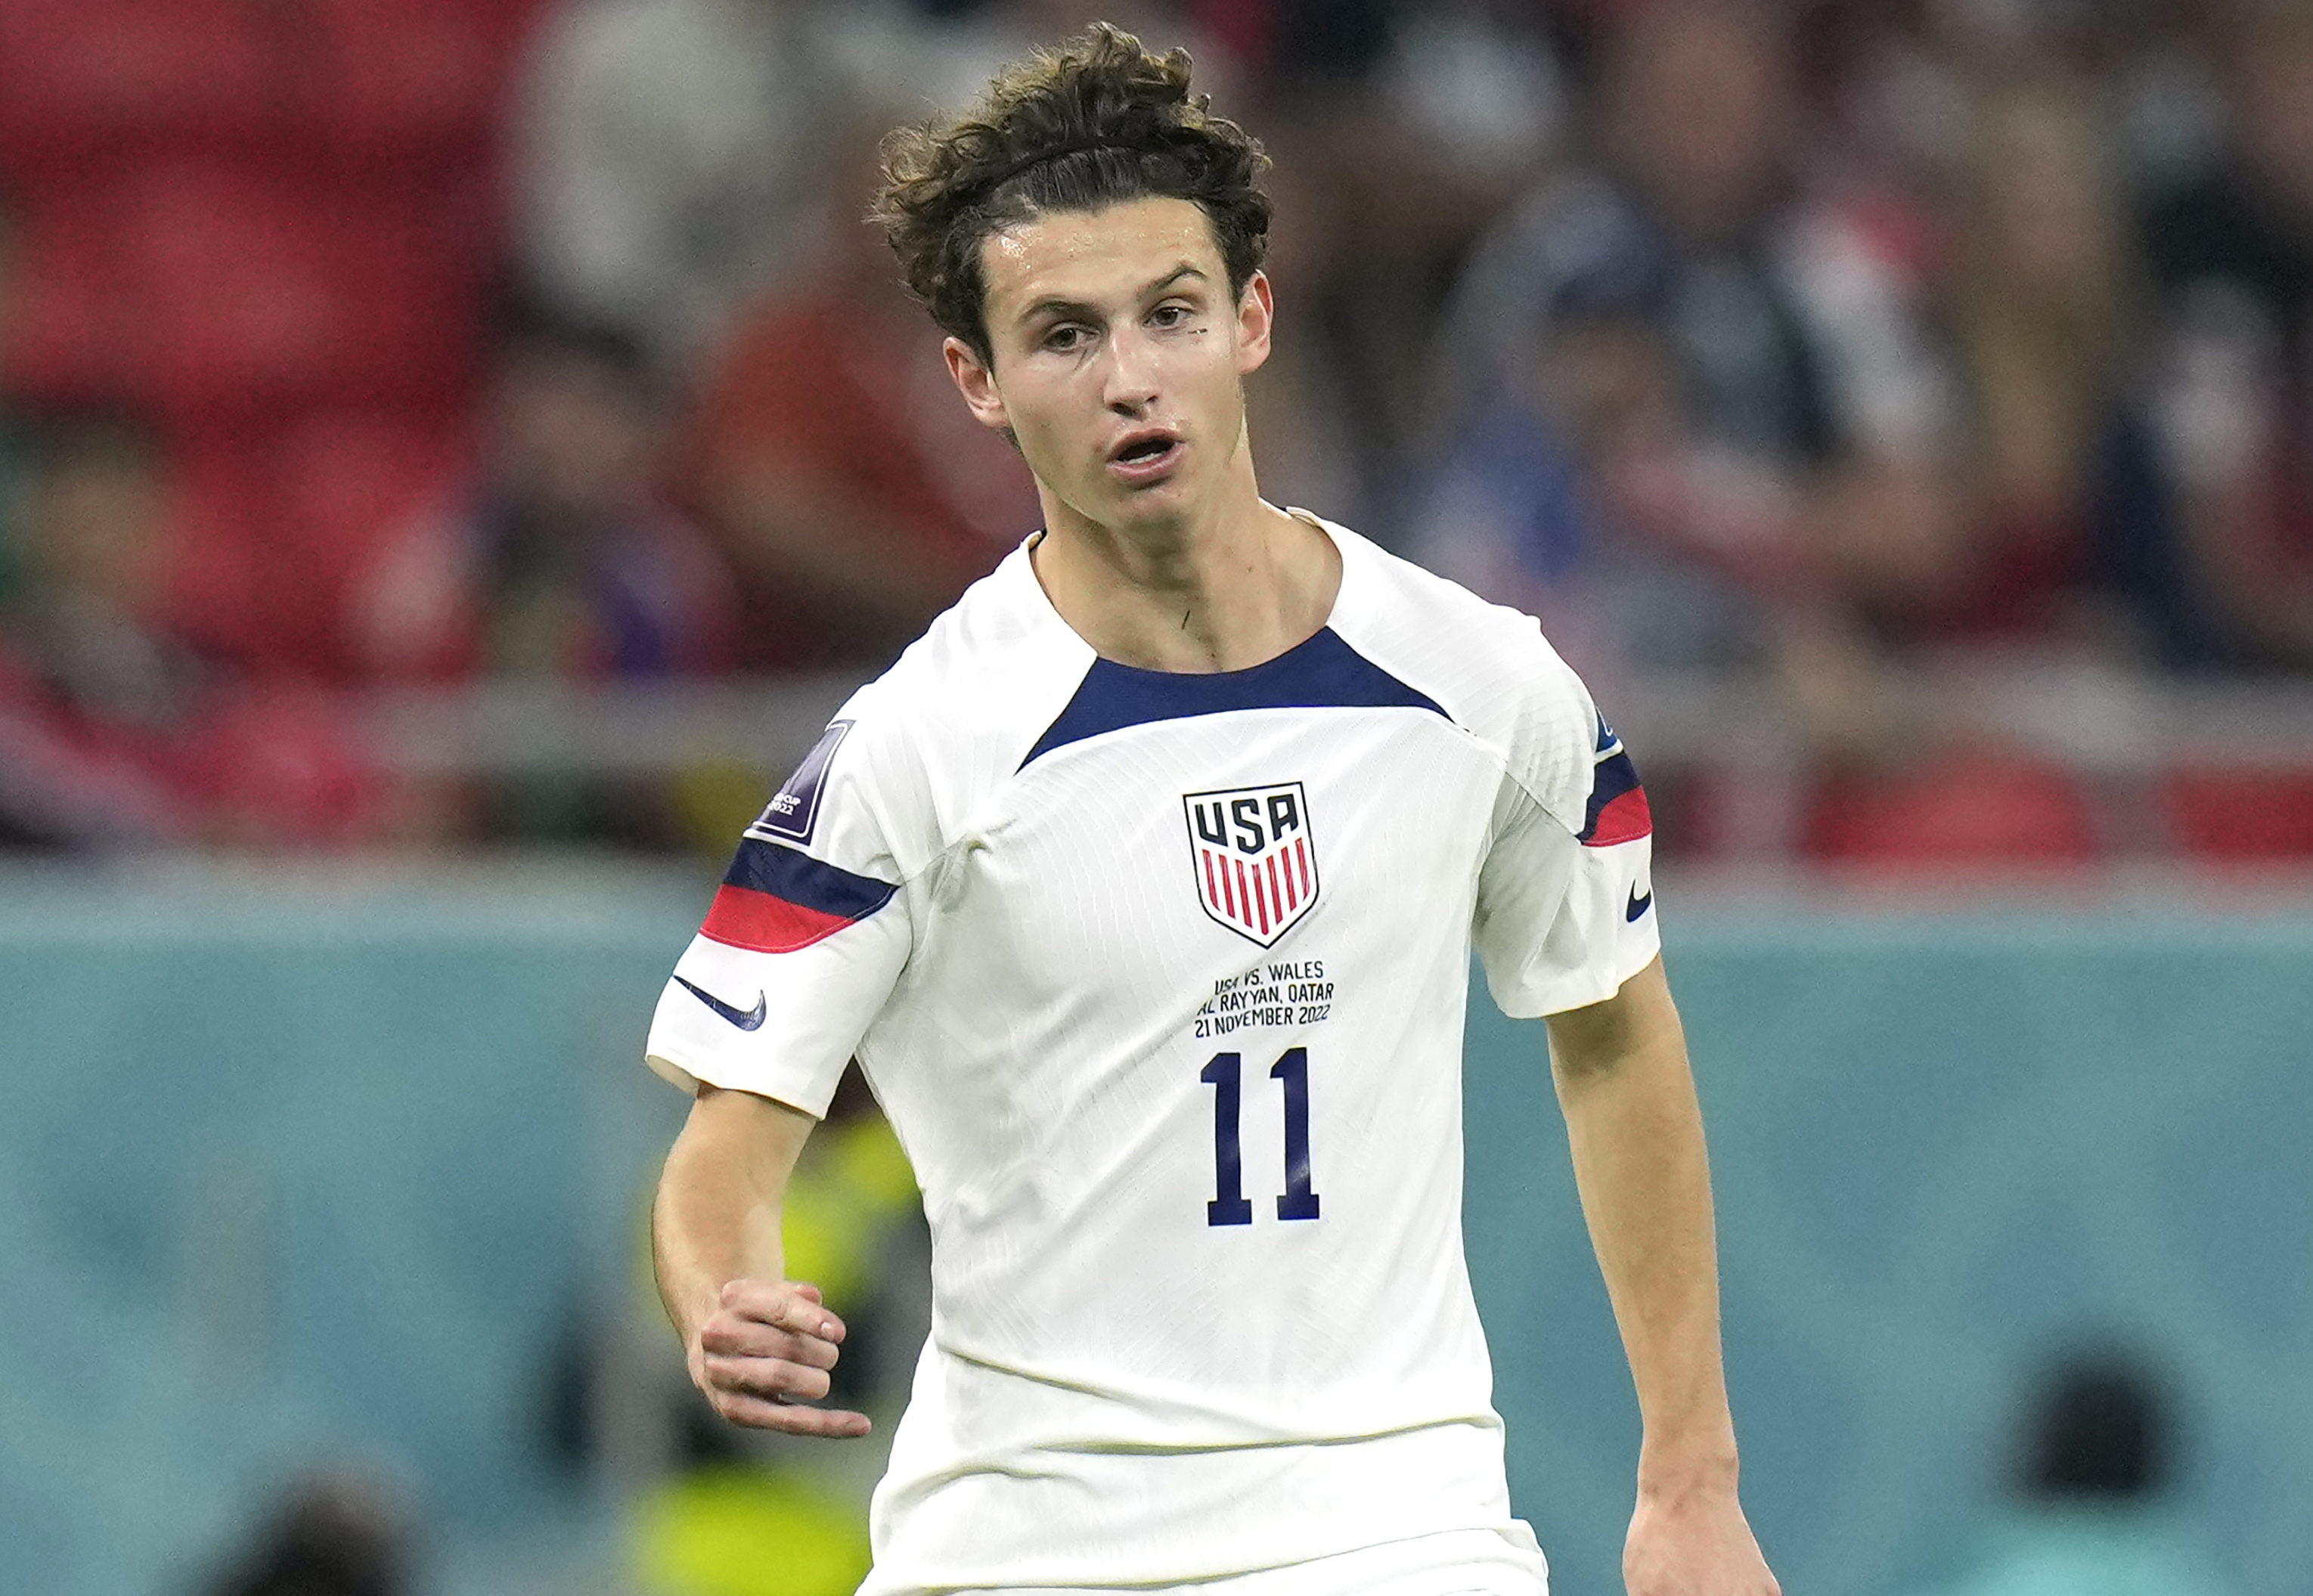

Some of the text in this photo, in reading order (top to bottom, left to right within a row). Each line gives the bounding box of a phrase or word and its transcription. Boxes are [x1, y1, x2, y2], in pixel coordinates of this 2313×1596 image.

[1195, 793, 1299, 855] USA
[1214, 961, 1323, 996] USA VS. WALES
[1197, 983, 1335, 1016] AL RAYYAN, QATAR
[1195, 1004, 1331, 1038] 21 NOVEMBER 2022
[1201, 1047, 1319, 1226] 11
